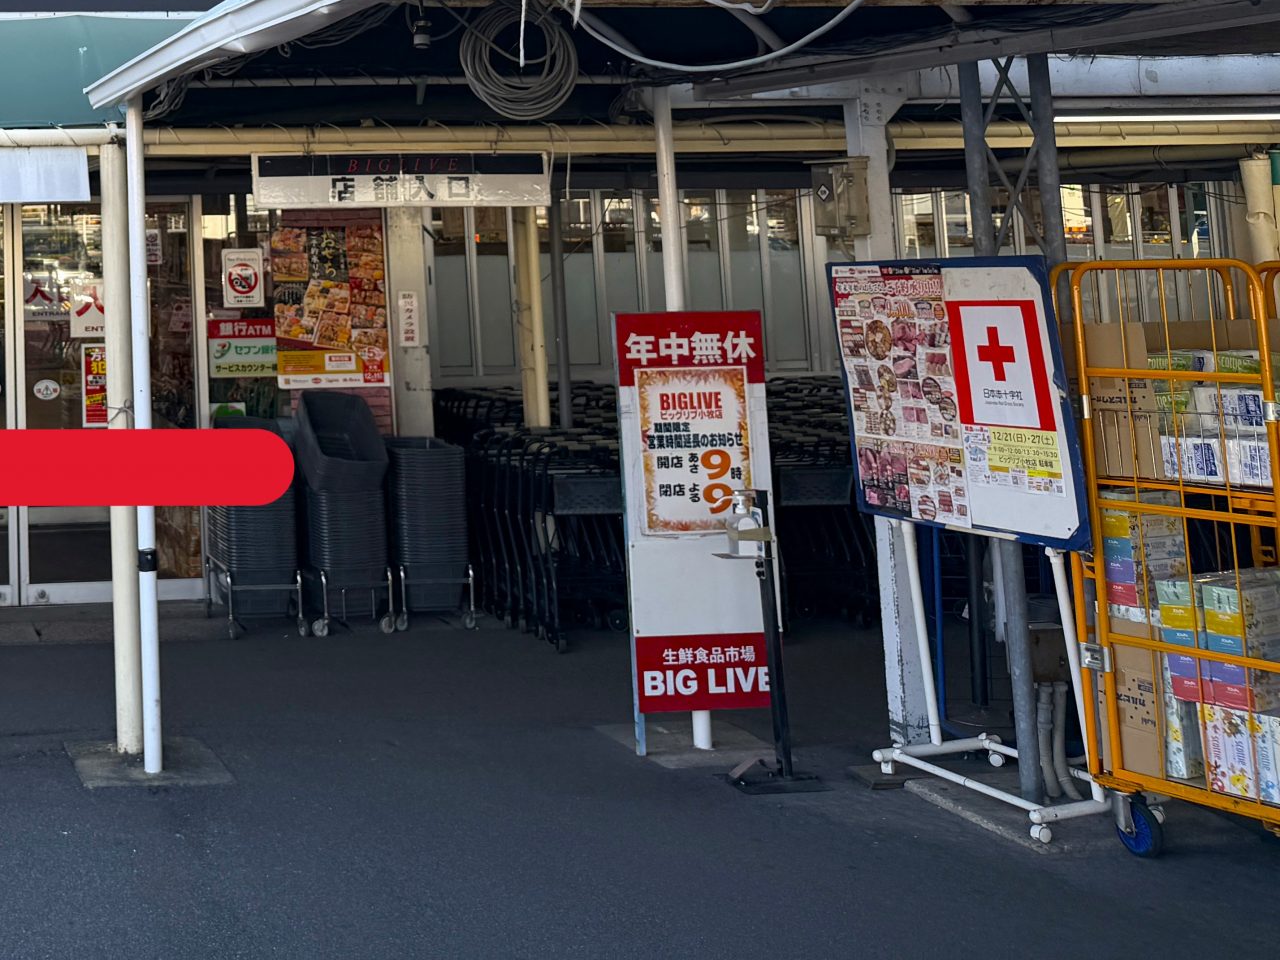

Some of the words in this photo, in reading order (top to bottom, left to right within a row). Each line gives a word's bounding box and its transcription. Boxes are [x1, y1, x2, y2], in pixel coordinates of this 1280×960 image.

[624, 330, 757, 366] 年中無休
[659, 391, 723, 411] BIGLIVE
[983, 388, 1023, 401] 日本赤十字社
[654, 422, 691, 433] 期間限定
[647, 432, 743, 450] 営業時間延長のお知らせ
[656, 455, 683, 469] 開店
[688, 452, 700, 474] あさ
[658, 483, 686, 498] 閉店
[688, 482, 701, 503] よる
[662, 645, 756, 666] 生鮮食品市場
[643, 668, 698, 697] BIG
[707, 665, 770, 694] LIVE
